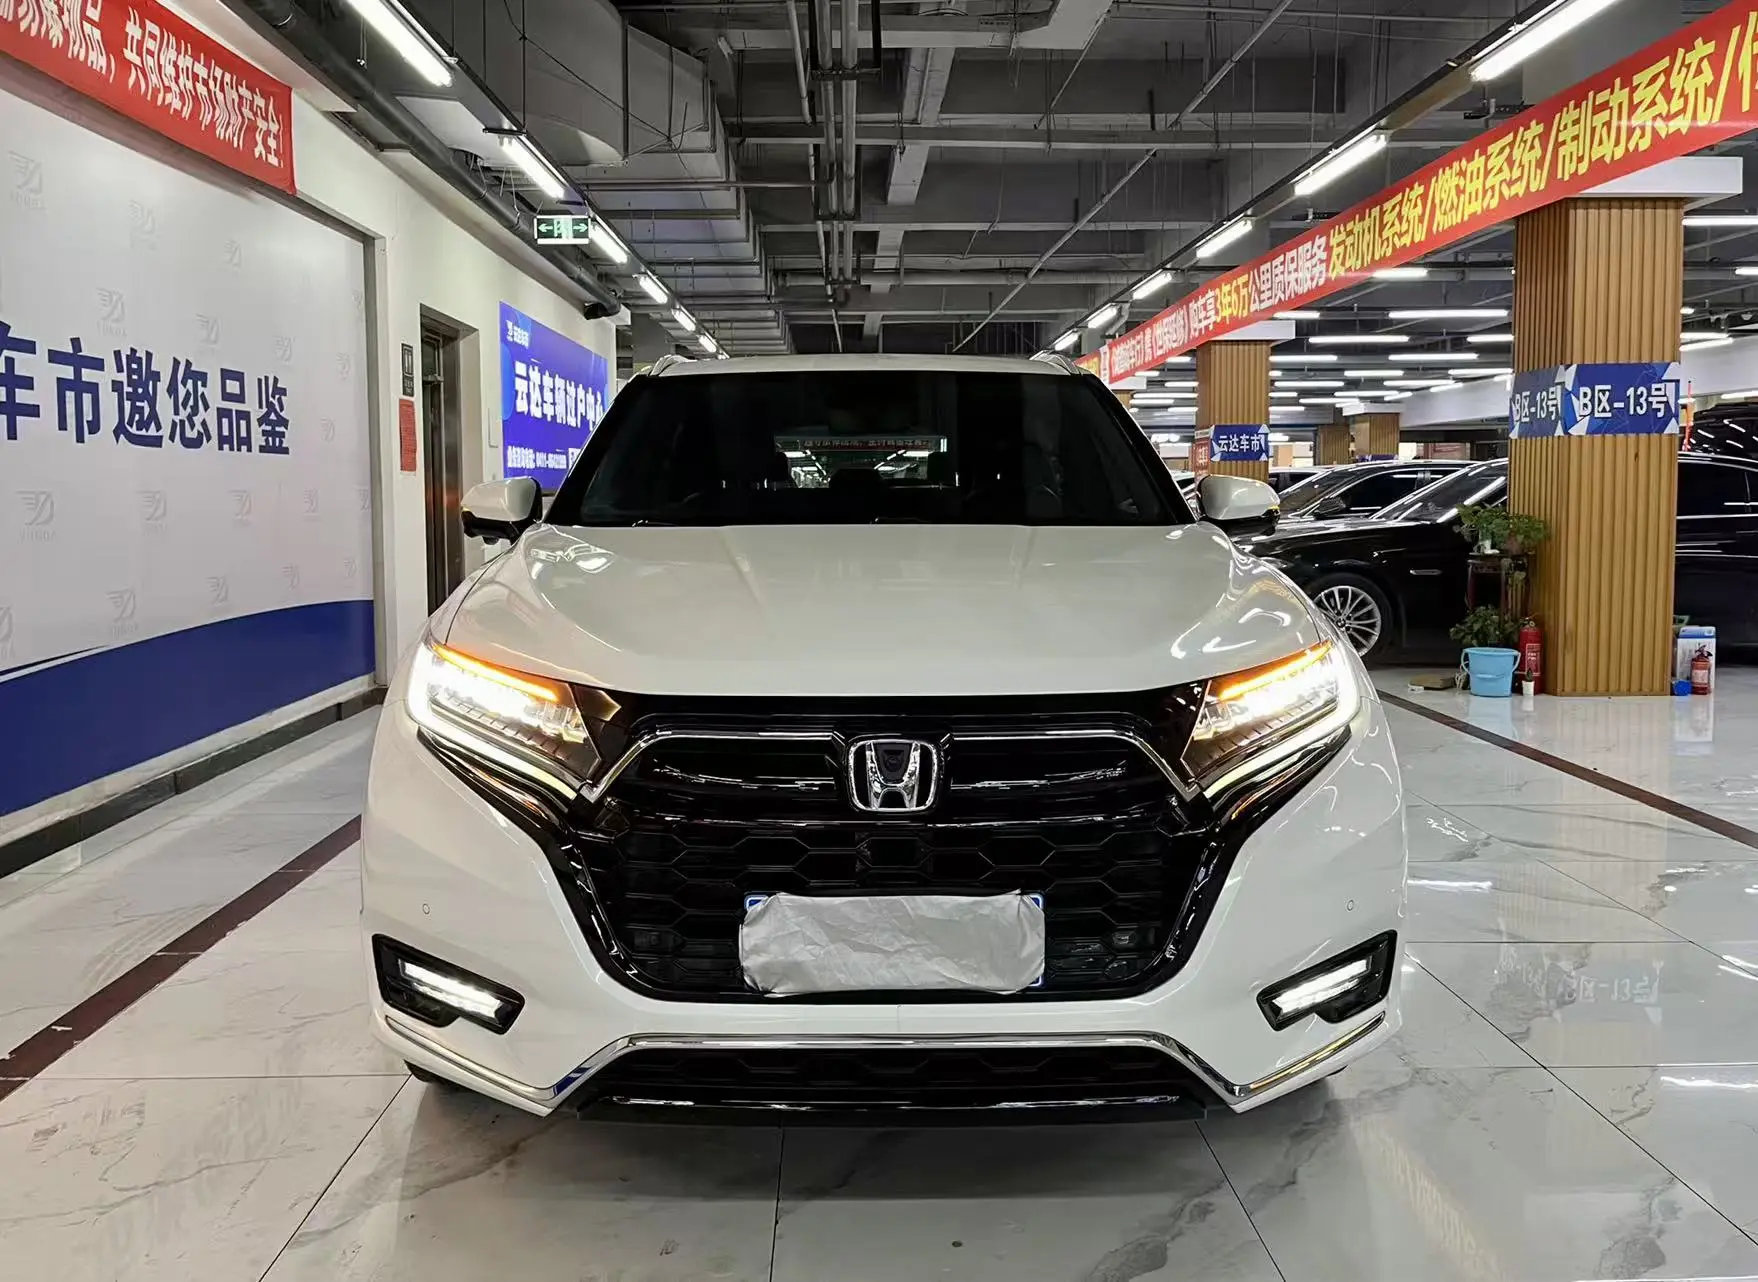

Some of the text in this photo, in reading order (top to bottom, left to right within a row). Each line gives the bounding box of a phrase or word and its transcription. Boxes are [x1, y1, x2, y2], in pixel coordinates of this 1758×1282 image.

[0, 320, 289, 455] 车市邀您品鉴
[1514, 387, 1556, 423] B区-13号
[1579, 383, 1667, 418] B区-13号
[1218, 433, 1261, 453] 云达车市
